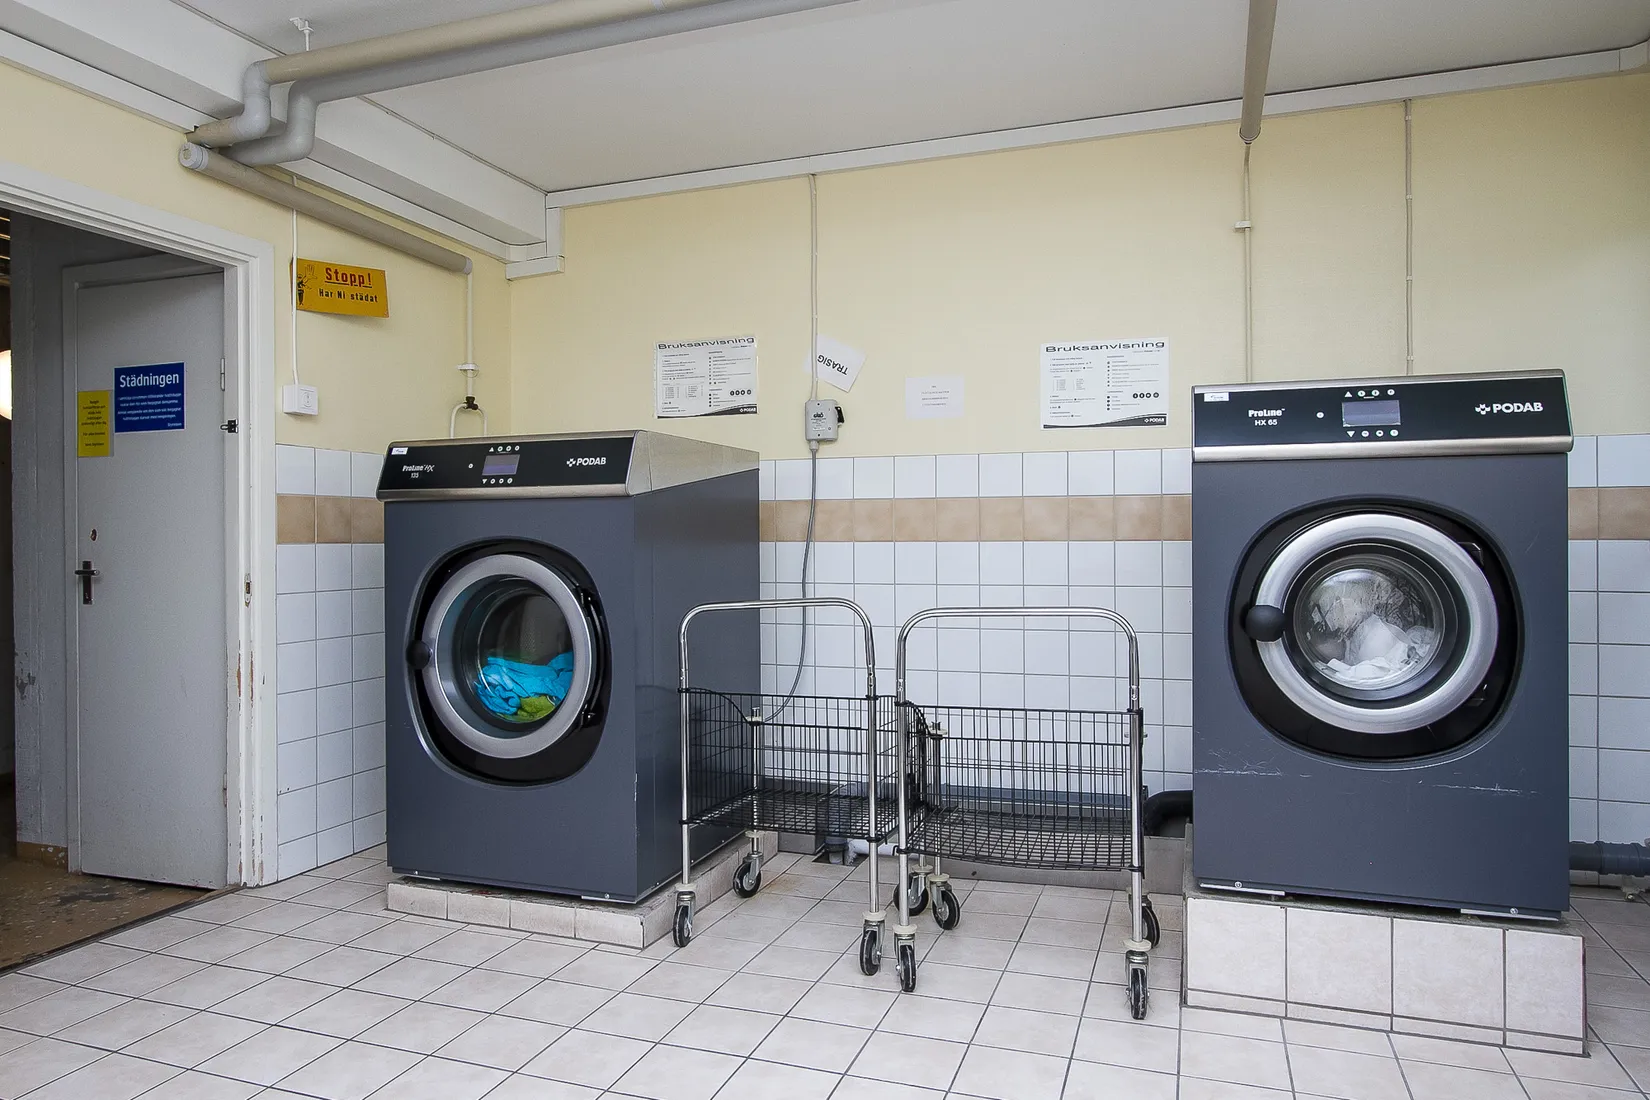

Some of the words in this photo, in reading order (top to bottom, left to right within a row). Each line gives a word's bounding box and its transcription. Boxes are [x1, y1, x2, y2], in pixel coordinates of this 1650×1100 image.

[325, 267, 372, 287] Stopp!
[319, 288, 333, 298] Har
[337, 290, 345, 299] Ni
[350, 292, 378, 302] städat
[658, 337, 755, 350] Bruksanvisning
[1045, 341, 1165, 353] Bruksanvisning
[817, 354, 848, 376] TRASIG
[119, 373, 179, 388] Städningen
[1492, 402, 1543, 414] PODAB
[576, 457, 607, 466] PODAB
